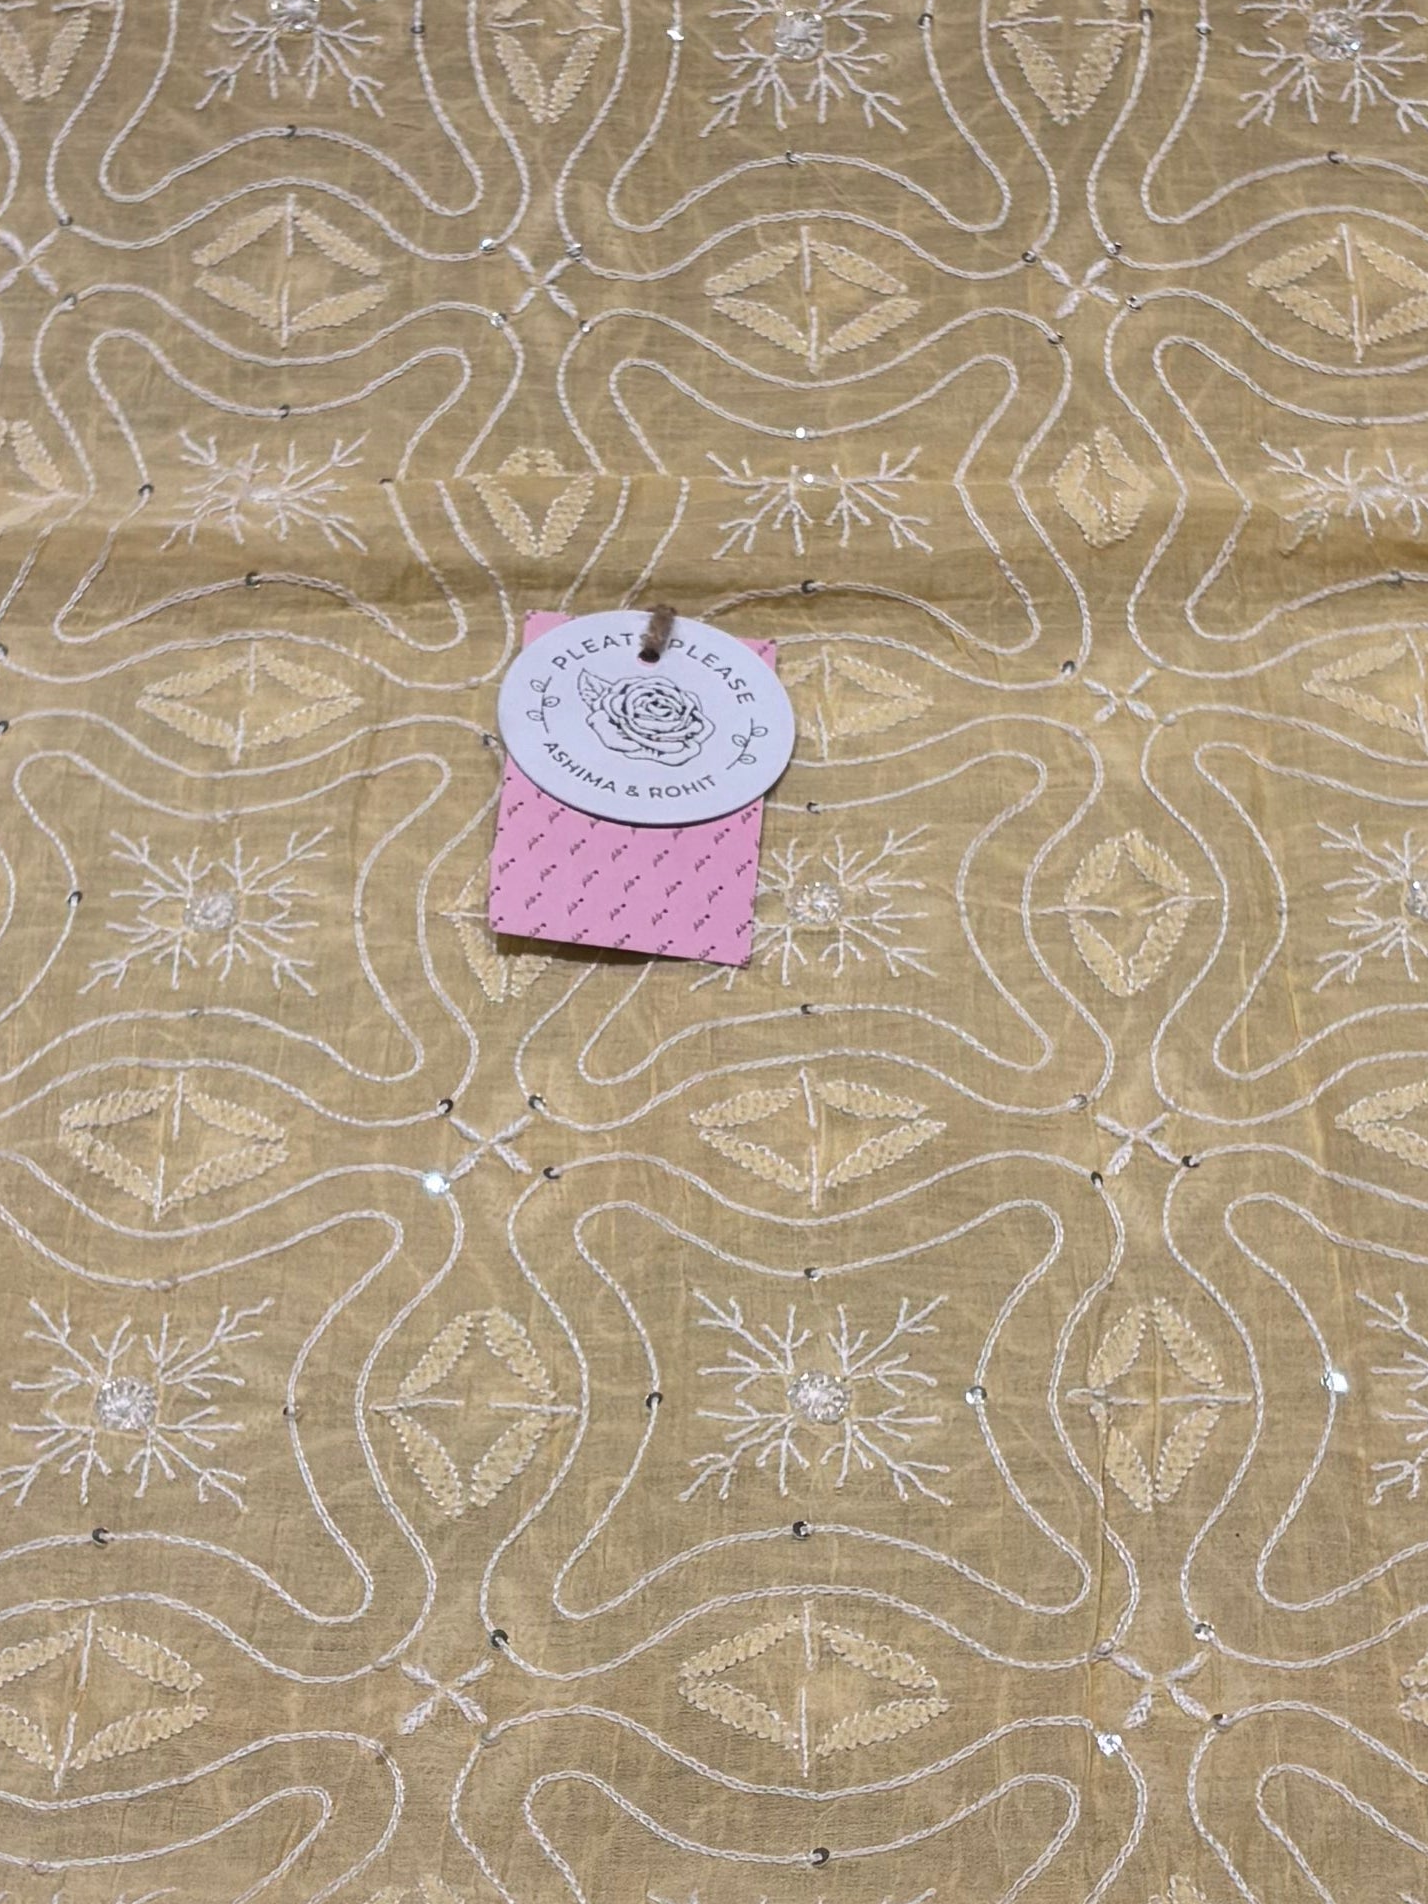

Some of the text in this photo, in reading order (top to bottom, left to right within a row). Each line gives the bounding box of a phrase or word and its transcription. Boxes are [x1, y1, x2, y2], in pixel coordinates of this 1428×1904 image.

[667, 637, 756, 705] PLEASE
[543, 741, 716, 799] ASHIMA & ROHIT
